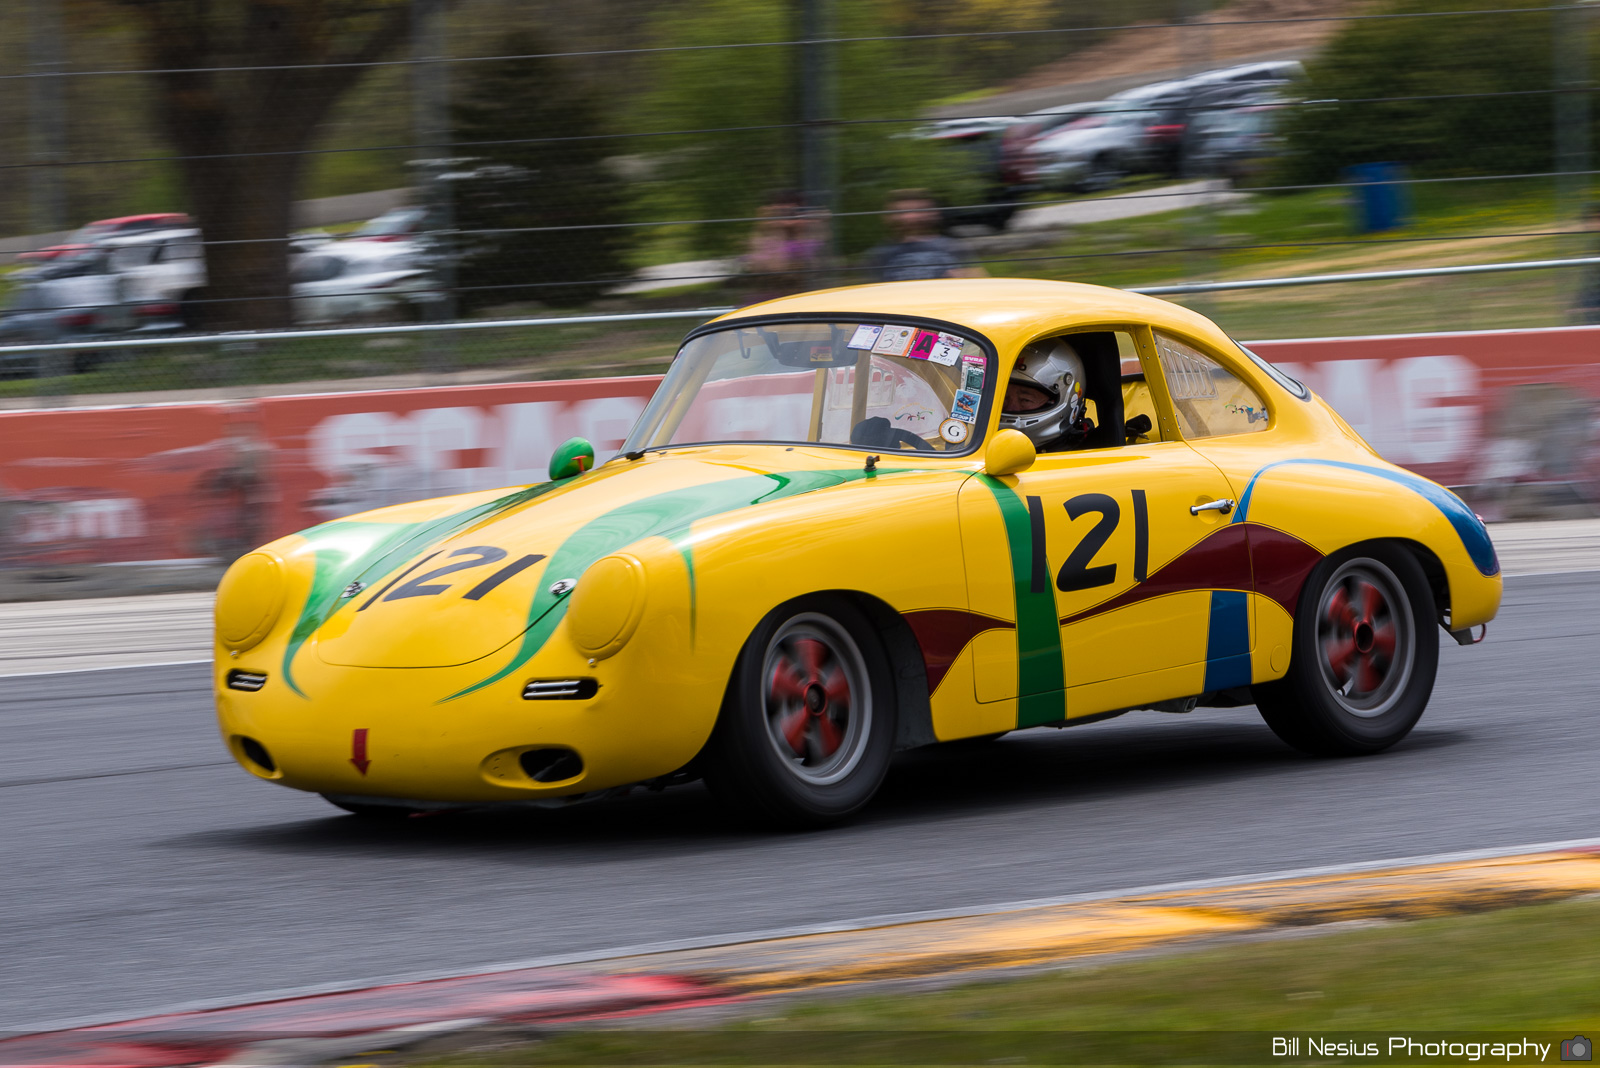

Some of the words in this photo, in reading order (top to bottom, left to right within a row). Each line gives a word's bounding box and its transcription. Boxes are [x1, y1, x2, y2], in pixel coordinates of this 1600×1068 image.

[878, 333, 895, 349] 3
[914, 334, 934, 354] A
[939, 346, 951, 358] 3
[947, 425, 960, 437] G
[1025, 489, 1149, 593] 121
[356, 545, 547, 613] 121
